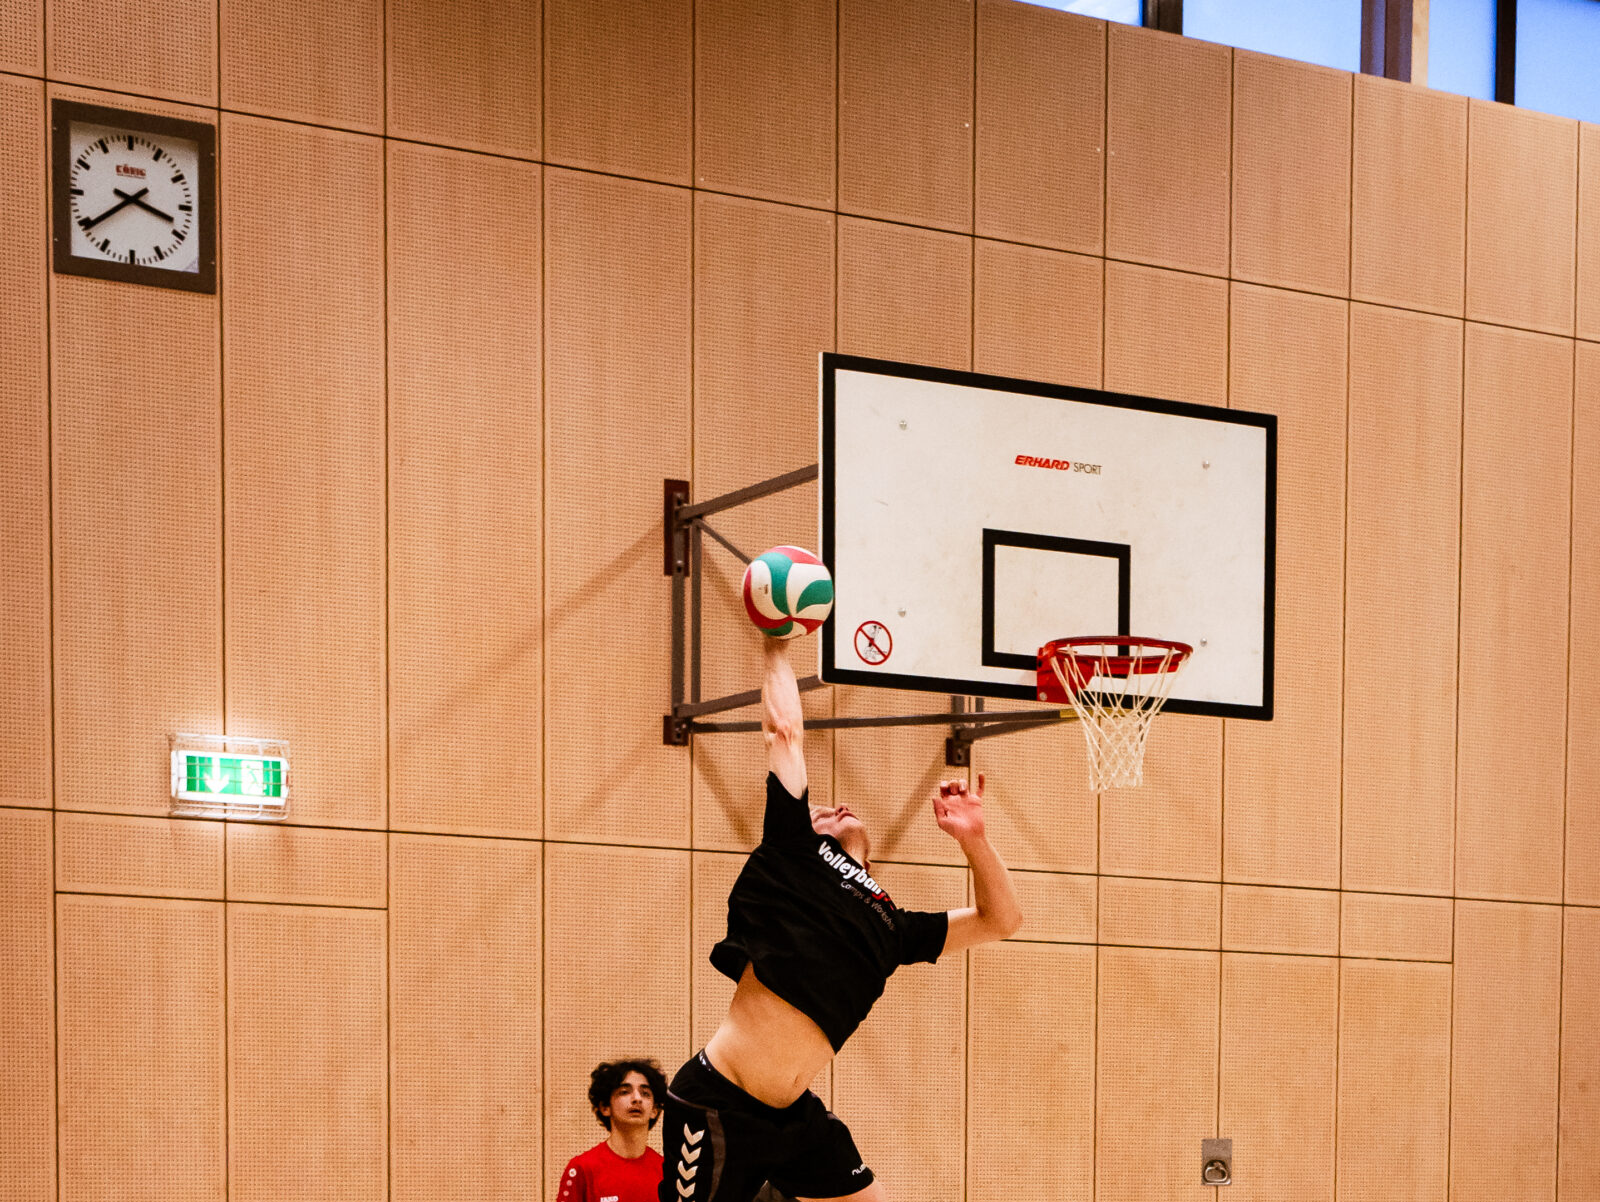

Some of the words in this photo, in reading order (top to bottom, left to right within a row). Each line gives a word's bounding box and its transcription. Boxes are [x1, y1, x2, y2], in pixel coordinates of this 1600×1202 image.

[1014, 455, 1070, 470] ERHARD
[1073, 462, 1103, 476] SPORT
[818, 841, 883, 895] Volleyball
